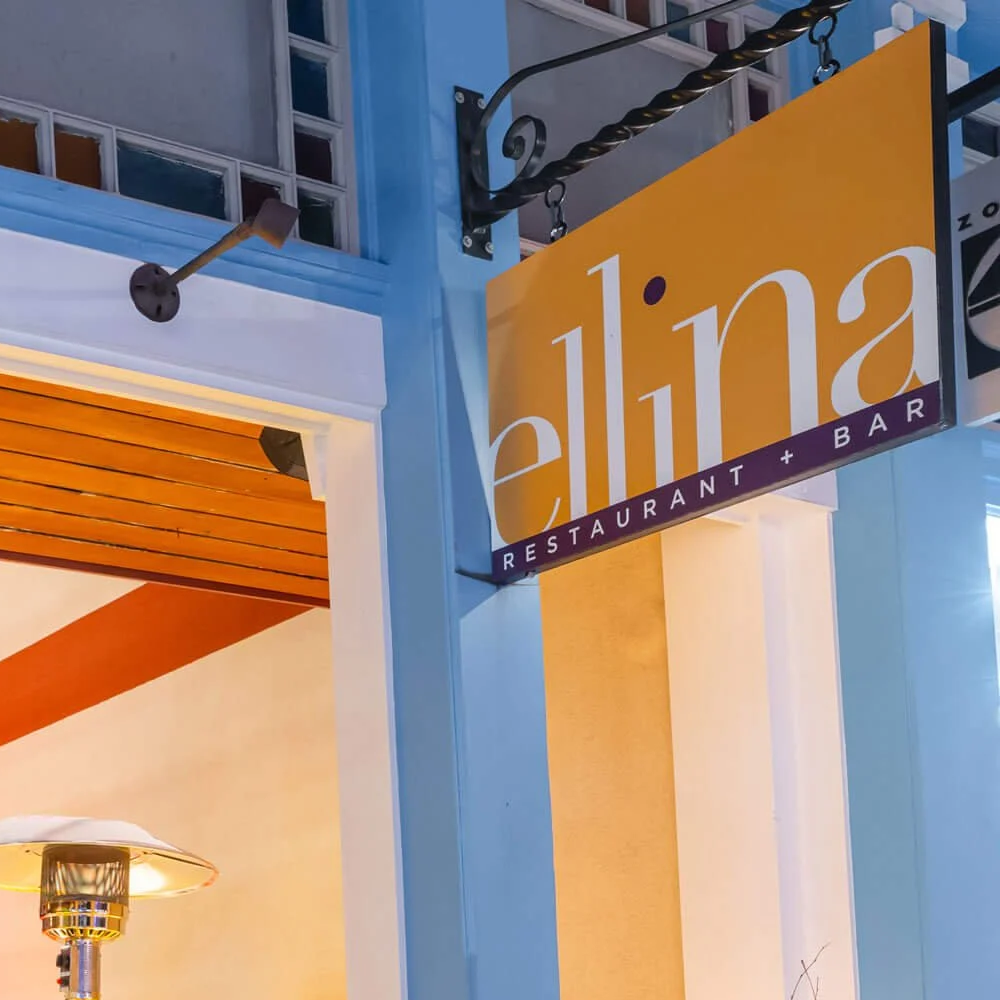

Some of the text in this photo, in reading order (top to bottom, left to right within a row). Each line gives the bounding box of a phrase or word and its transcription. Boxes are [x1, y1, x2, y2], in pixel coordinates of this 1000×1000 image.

[488, 245, 939, 551] ellina
[503, 465, 744, 571] RESTAURANT
[833, 397, 925, 450] BAR
